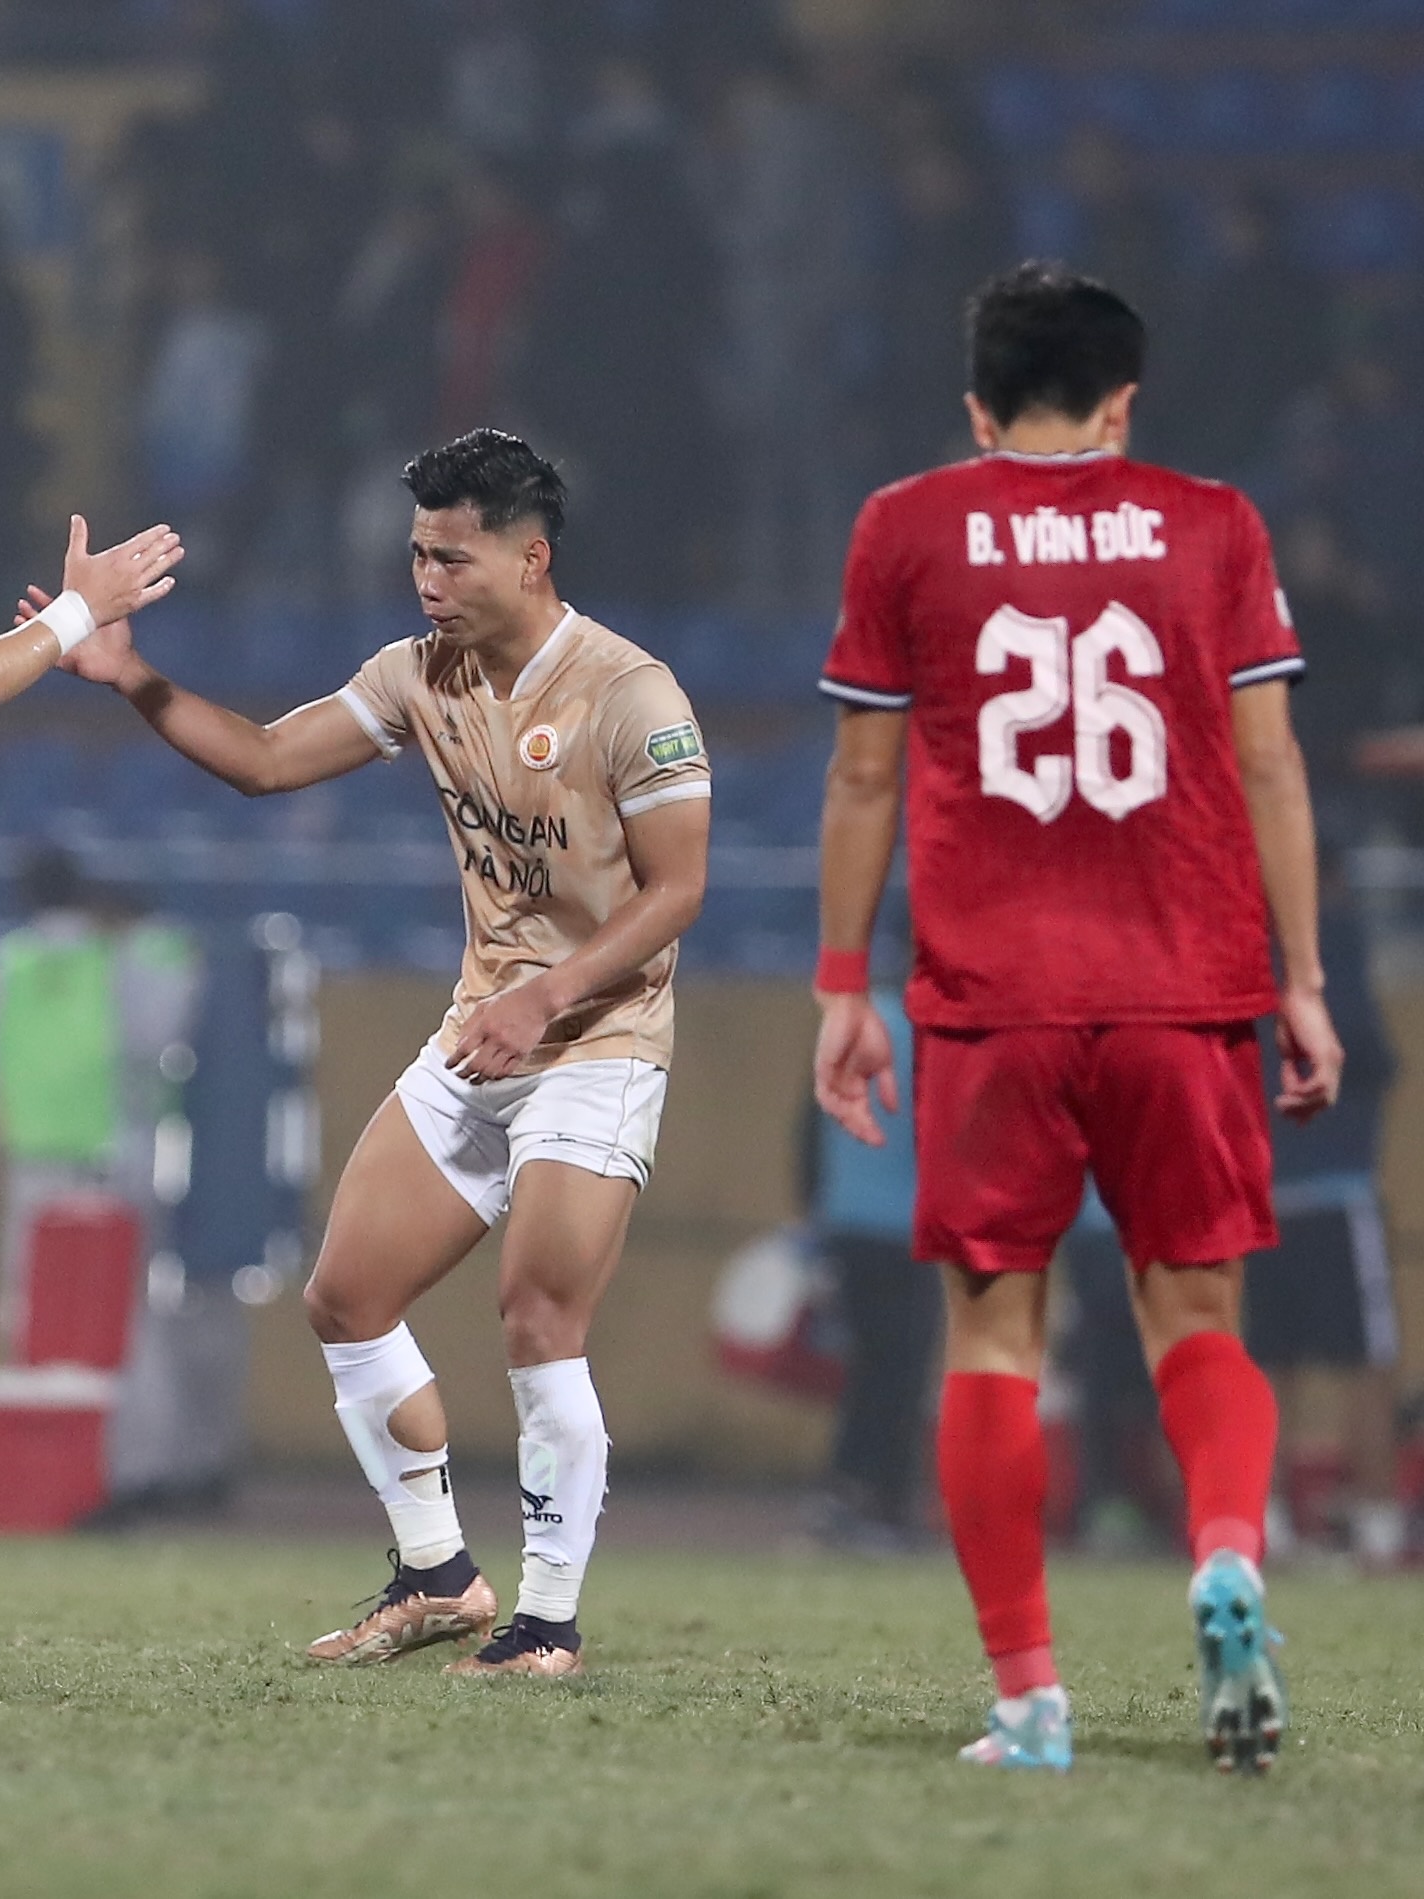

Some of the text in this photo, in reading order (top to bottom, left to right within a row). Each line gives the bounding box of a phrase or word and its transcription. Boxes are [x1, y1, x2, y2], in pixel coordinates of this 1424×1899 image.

[966, 500, 1167, 566] B. VĂN ĐỨC
[975, 600, 1168, 824] 26
